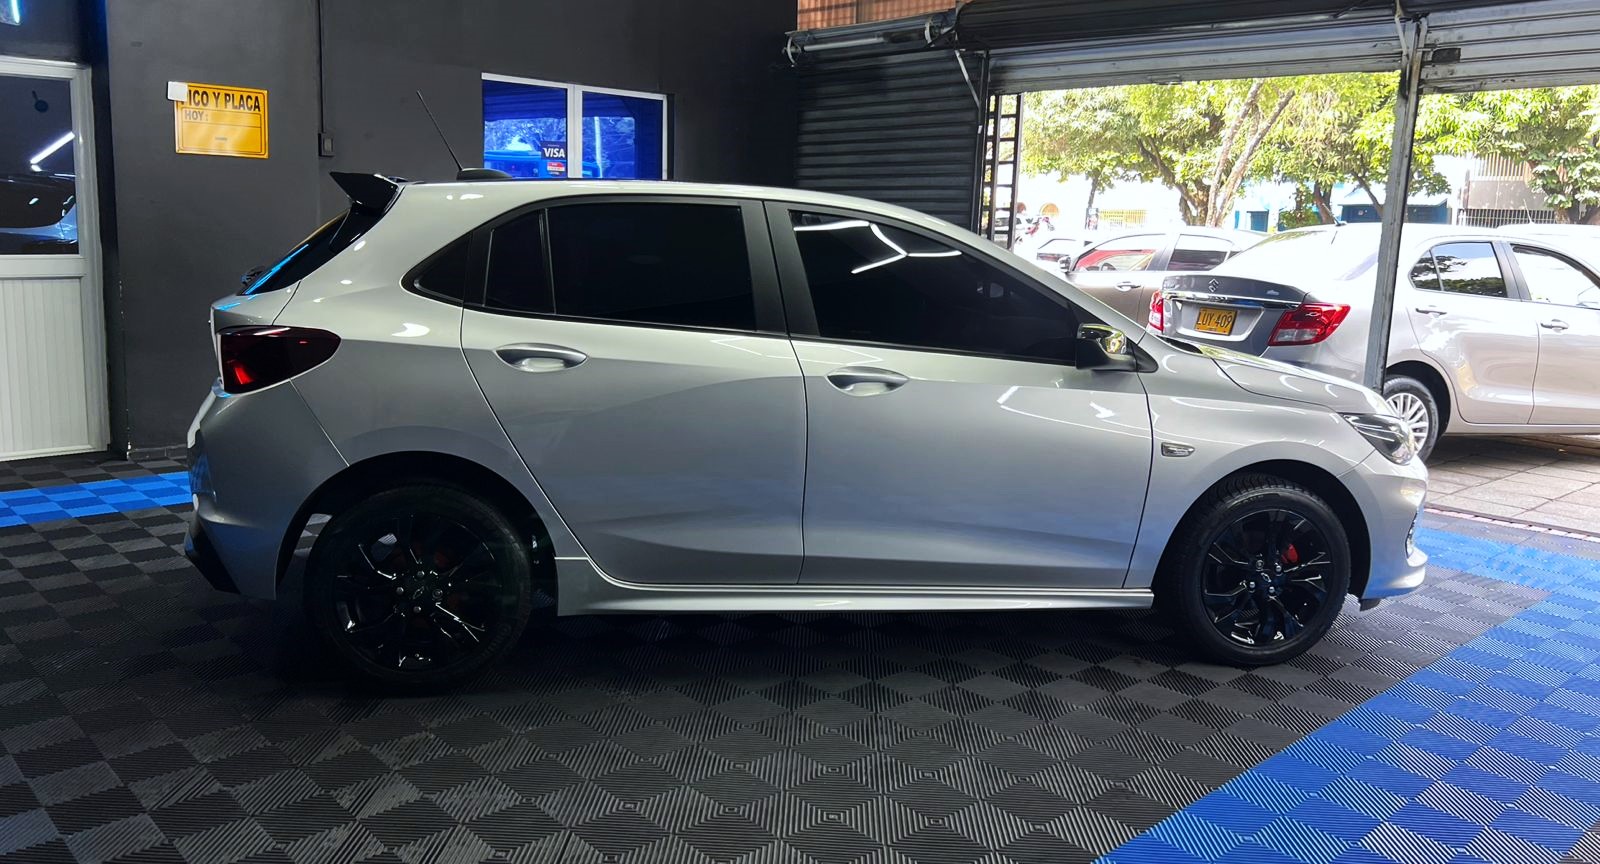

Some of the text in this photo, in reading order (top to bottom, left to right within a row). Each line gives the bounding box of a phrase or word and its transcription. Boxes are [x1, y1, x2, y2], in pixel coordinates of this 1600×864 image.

[182, 89, 261, 112] ICO Y PLACA
[542, 147, 566, 158] VISA
[1215, 312, 1233, 328] 409
